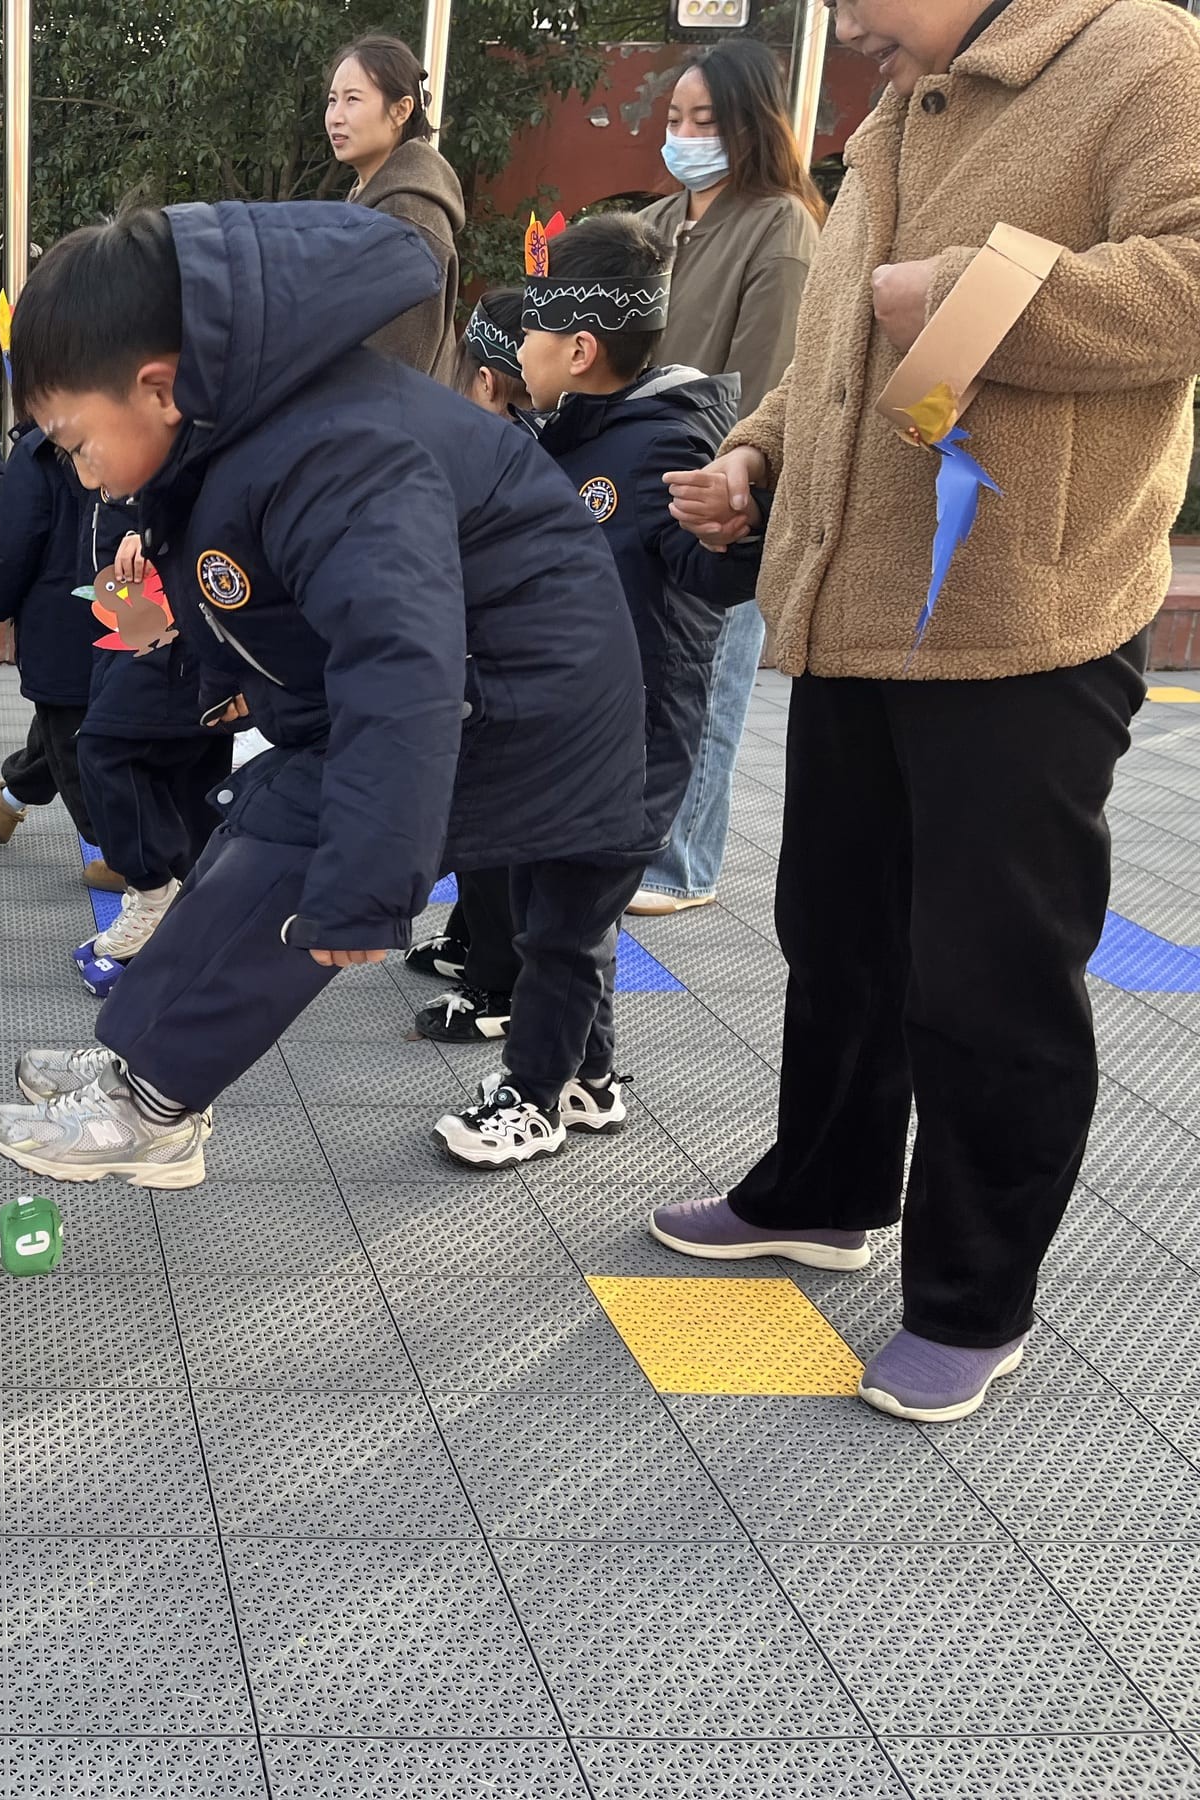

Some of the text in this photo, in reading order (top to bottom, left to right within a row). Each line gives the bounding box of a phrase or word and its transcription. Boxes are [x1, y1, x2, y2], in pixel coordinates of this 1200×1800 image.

[94, 957, 115, 972] B
[88, 1119, 123, 1146] N
[15, 1230, 51, 1256] C
